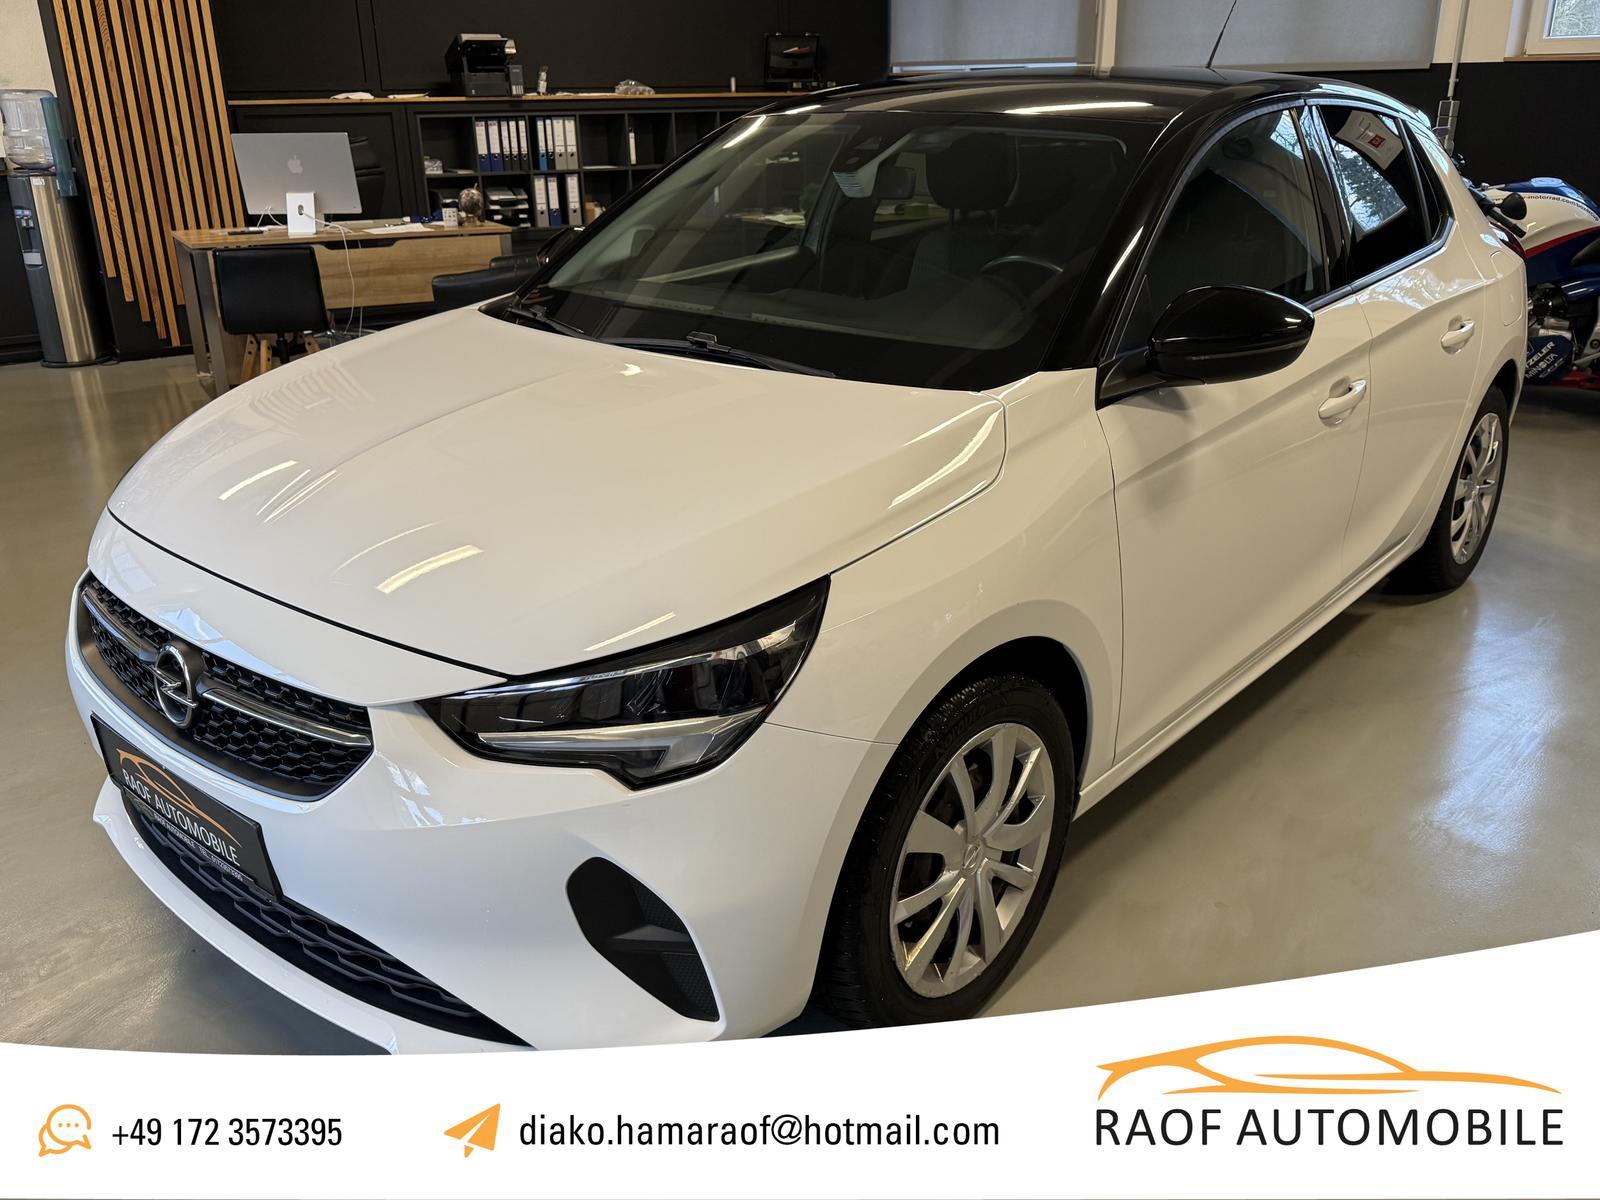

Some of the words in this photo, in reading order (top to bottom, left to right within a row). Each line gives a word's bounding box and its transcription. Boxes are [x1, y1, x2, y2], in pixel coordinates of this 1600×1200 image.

[1526, 341, 1555, 369] TZELER
[122, 768, 152, 802] RAOF
[154, 793, 241, 867] AUTOMOBILE
